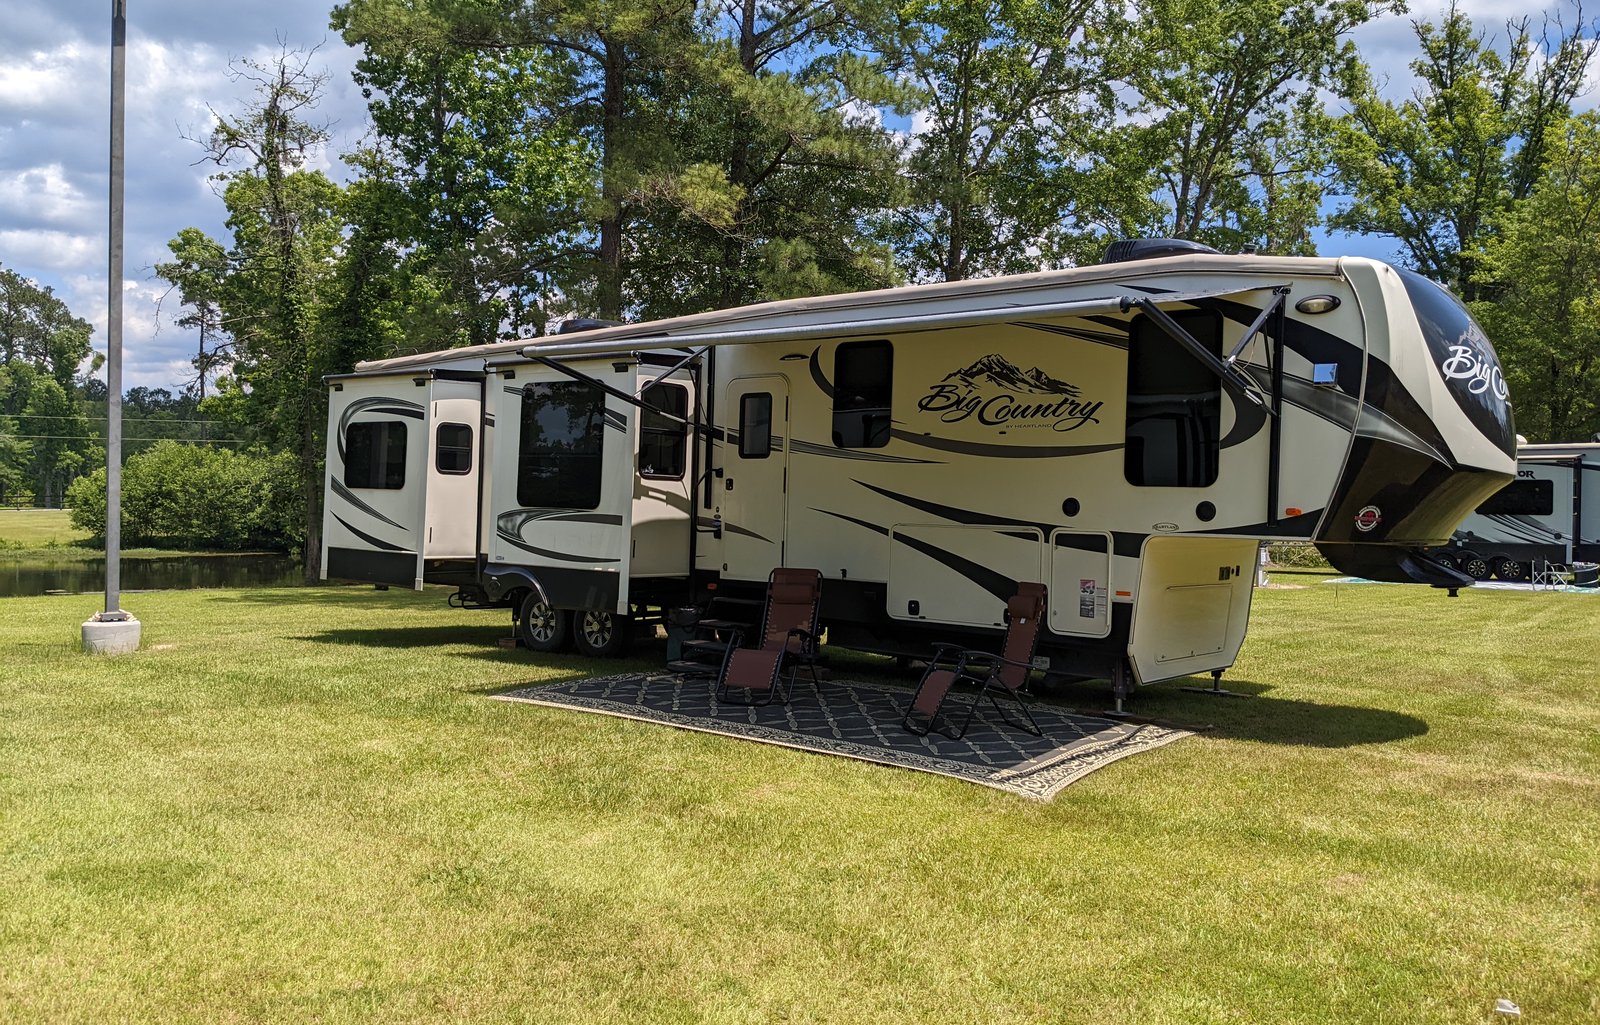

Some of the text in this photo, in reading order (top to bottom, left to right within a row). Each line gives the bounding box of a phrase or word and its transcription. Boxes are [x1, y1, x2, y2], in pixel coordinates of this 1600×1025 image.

[1442, 345, 1491, 394] Big
[918, 384, 1104, 433] Big Country
[1517, 470, 1536, 480] OR
